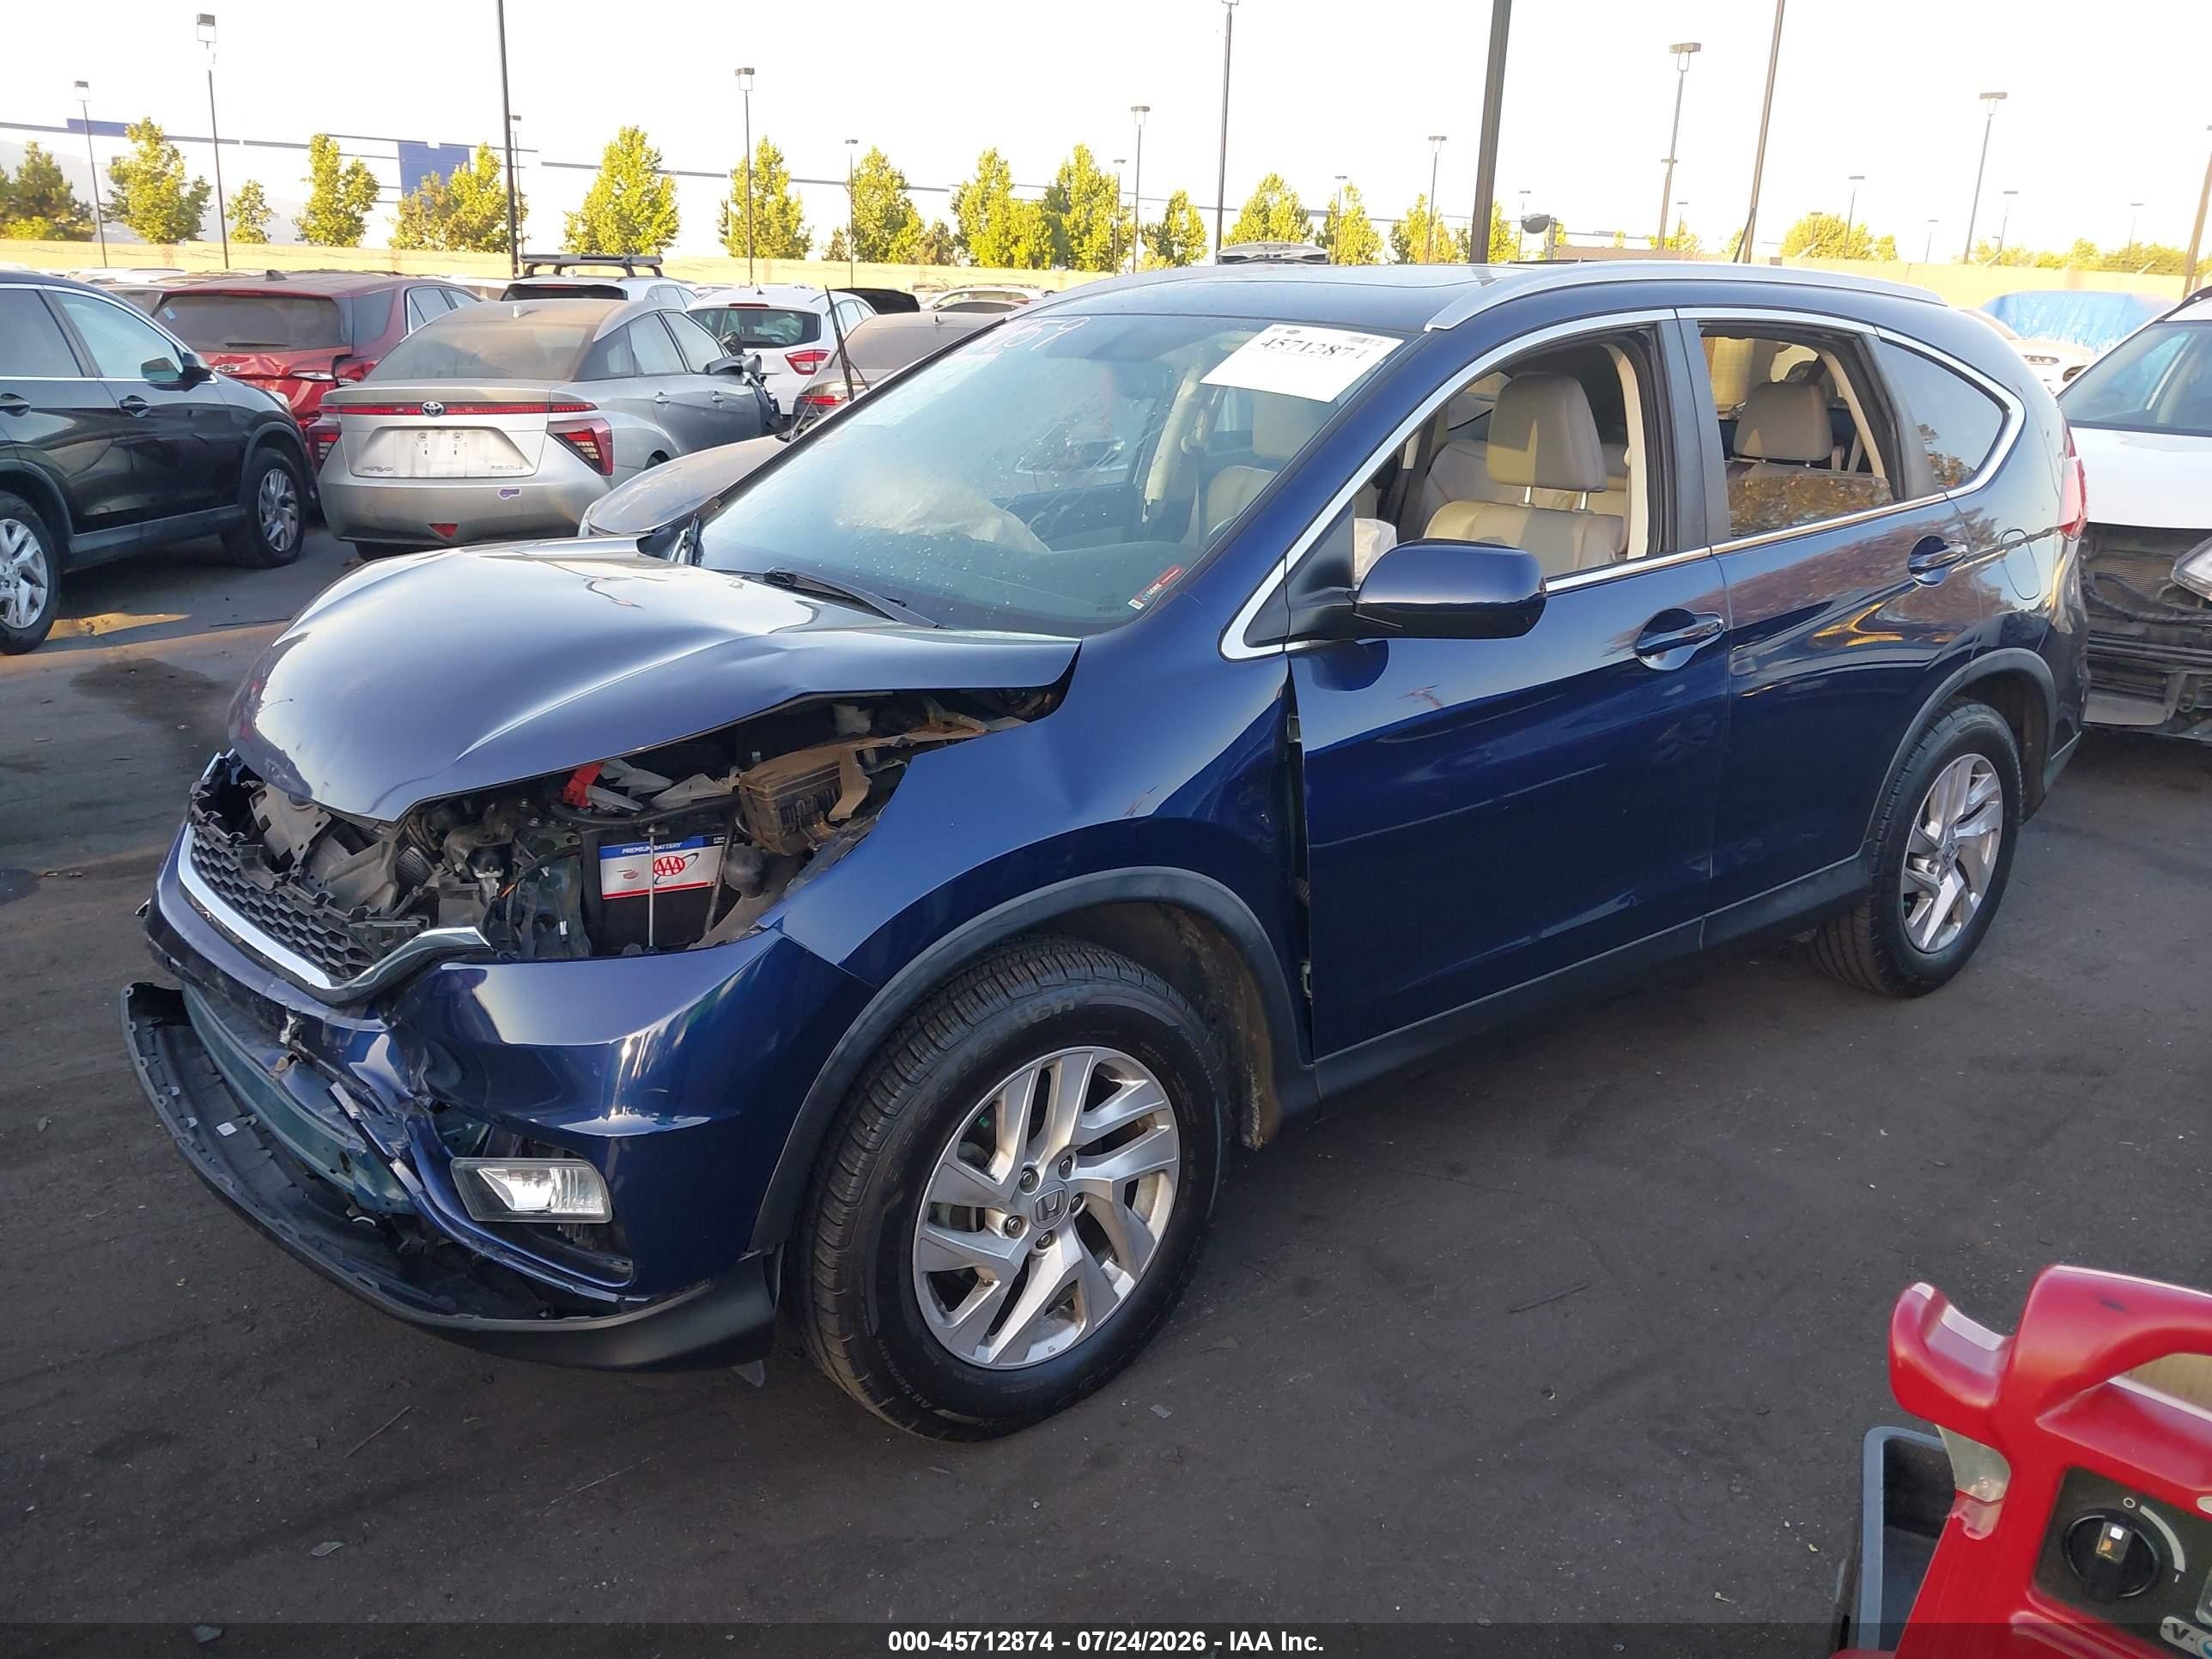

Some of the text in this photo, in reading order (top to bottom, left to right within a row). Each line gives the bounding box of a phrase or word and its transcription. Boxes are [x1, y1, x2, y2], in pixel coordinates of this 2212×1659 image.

[622, 842, 682, 854] PREMIUM BATTERY
[654, 857, 684, 876] AAA
